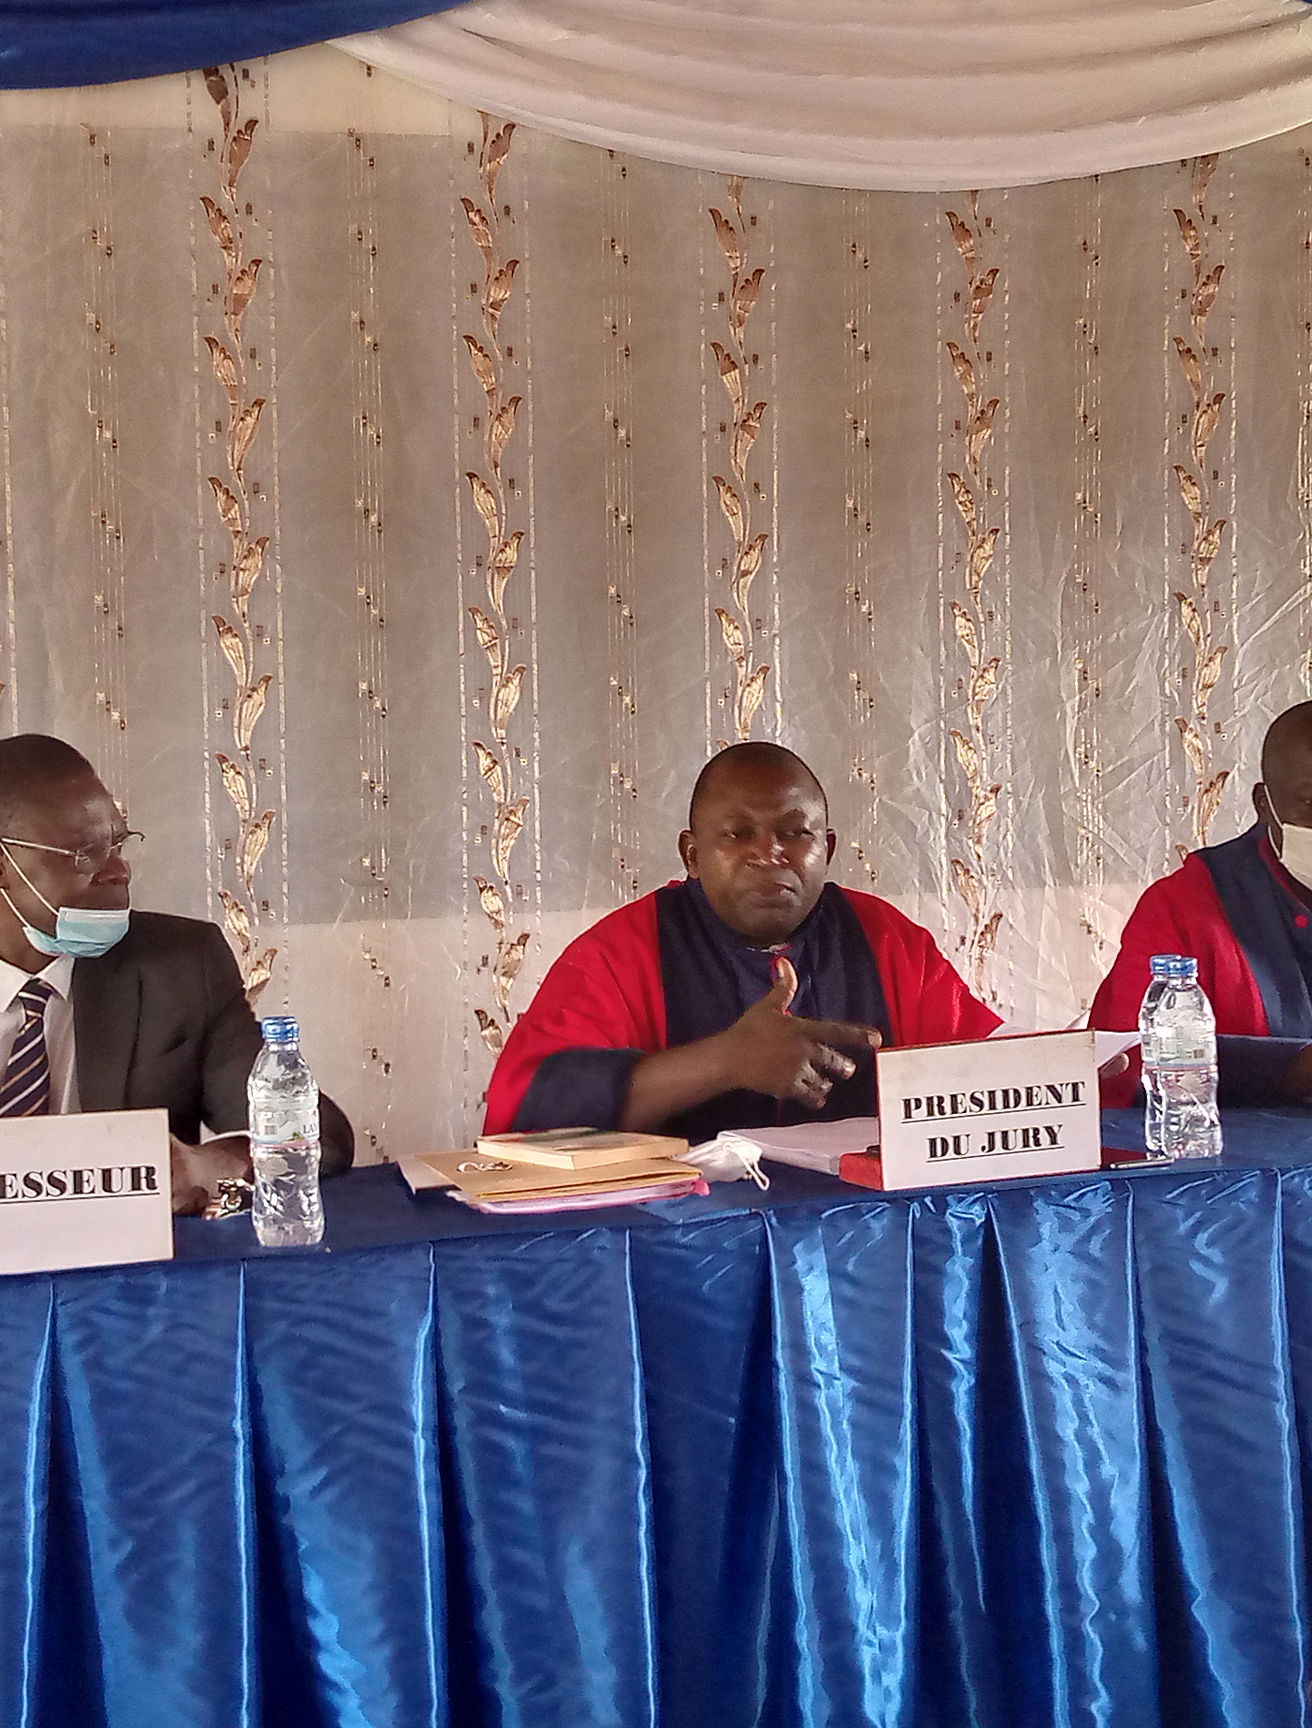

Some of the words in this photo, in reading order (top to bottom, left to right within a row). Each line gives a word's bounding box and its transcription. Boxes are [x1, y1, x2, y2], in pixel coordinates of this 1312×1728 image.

[901, 1081, 1085, 1120] PRESIDENT
[928, 1133, 971, 1159] DU
[980, 1124, 1063, 1154] JURY
